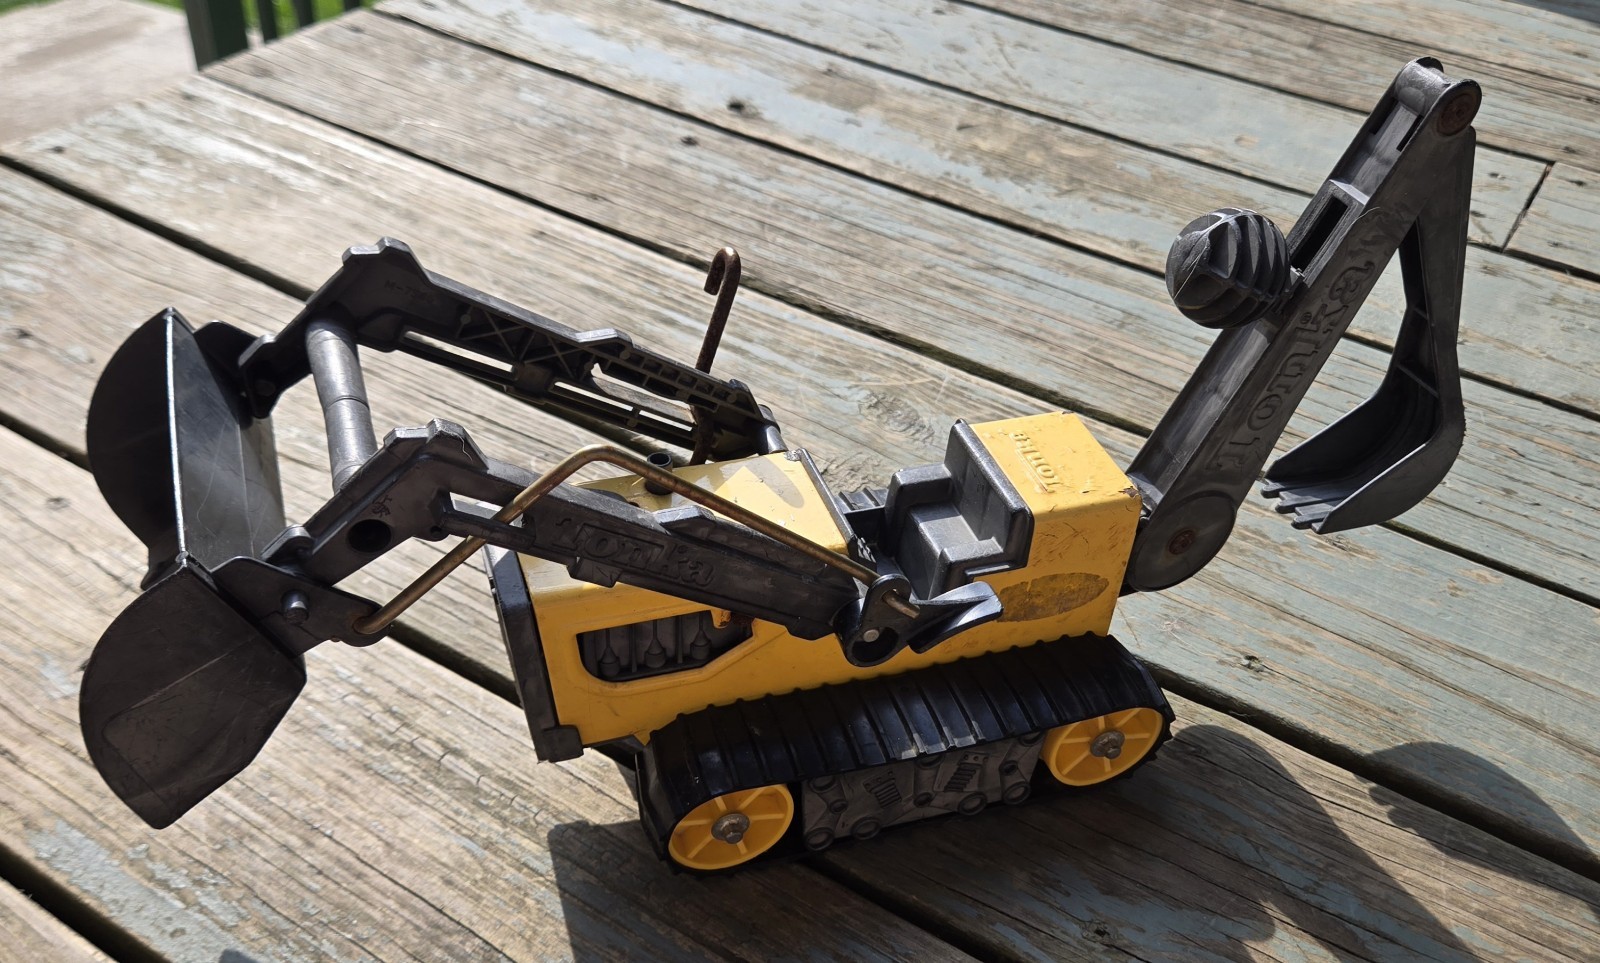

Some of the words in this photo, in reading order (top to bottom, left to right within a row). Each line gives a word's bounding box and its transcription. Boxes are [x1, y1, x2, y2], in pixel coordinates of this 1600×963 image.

[1206, 260, 1375, 472] Tonka
[1008, 432, 1061, 495] Tonka
[551, 516, 714, 588] Tonka
